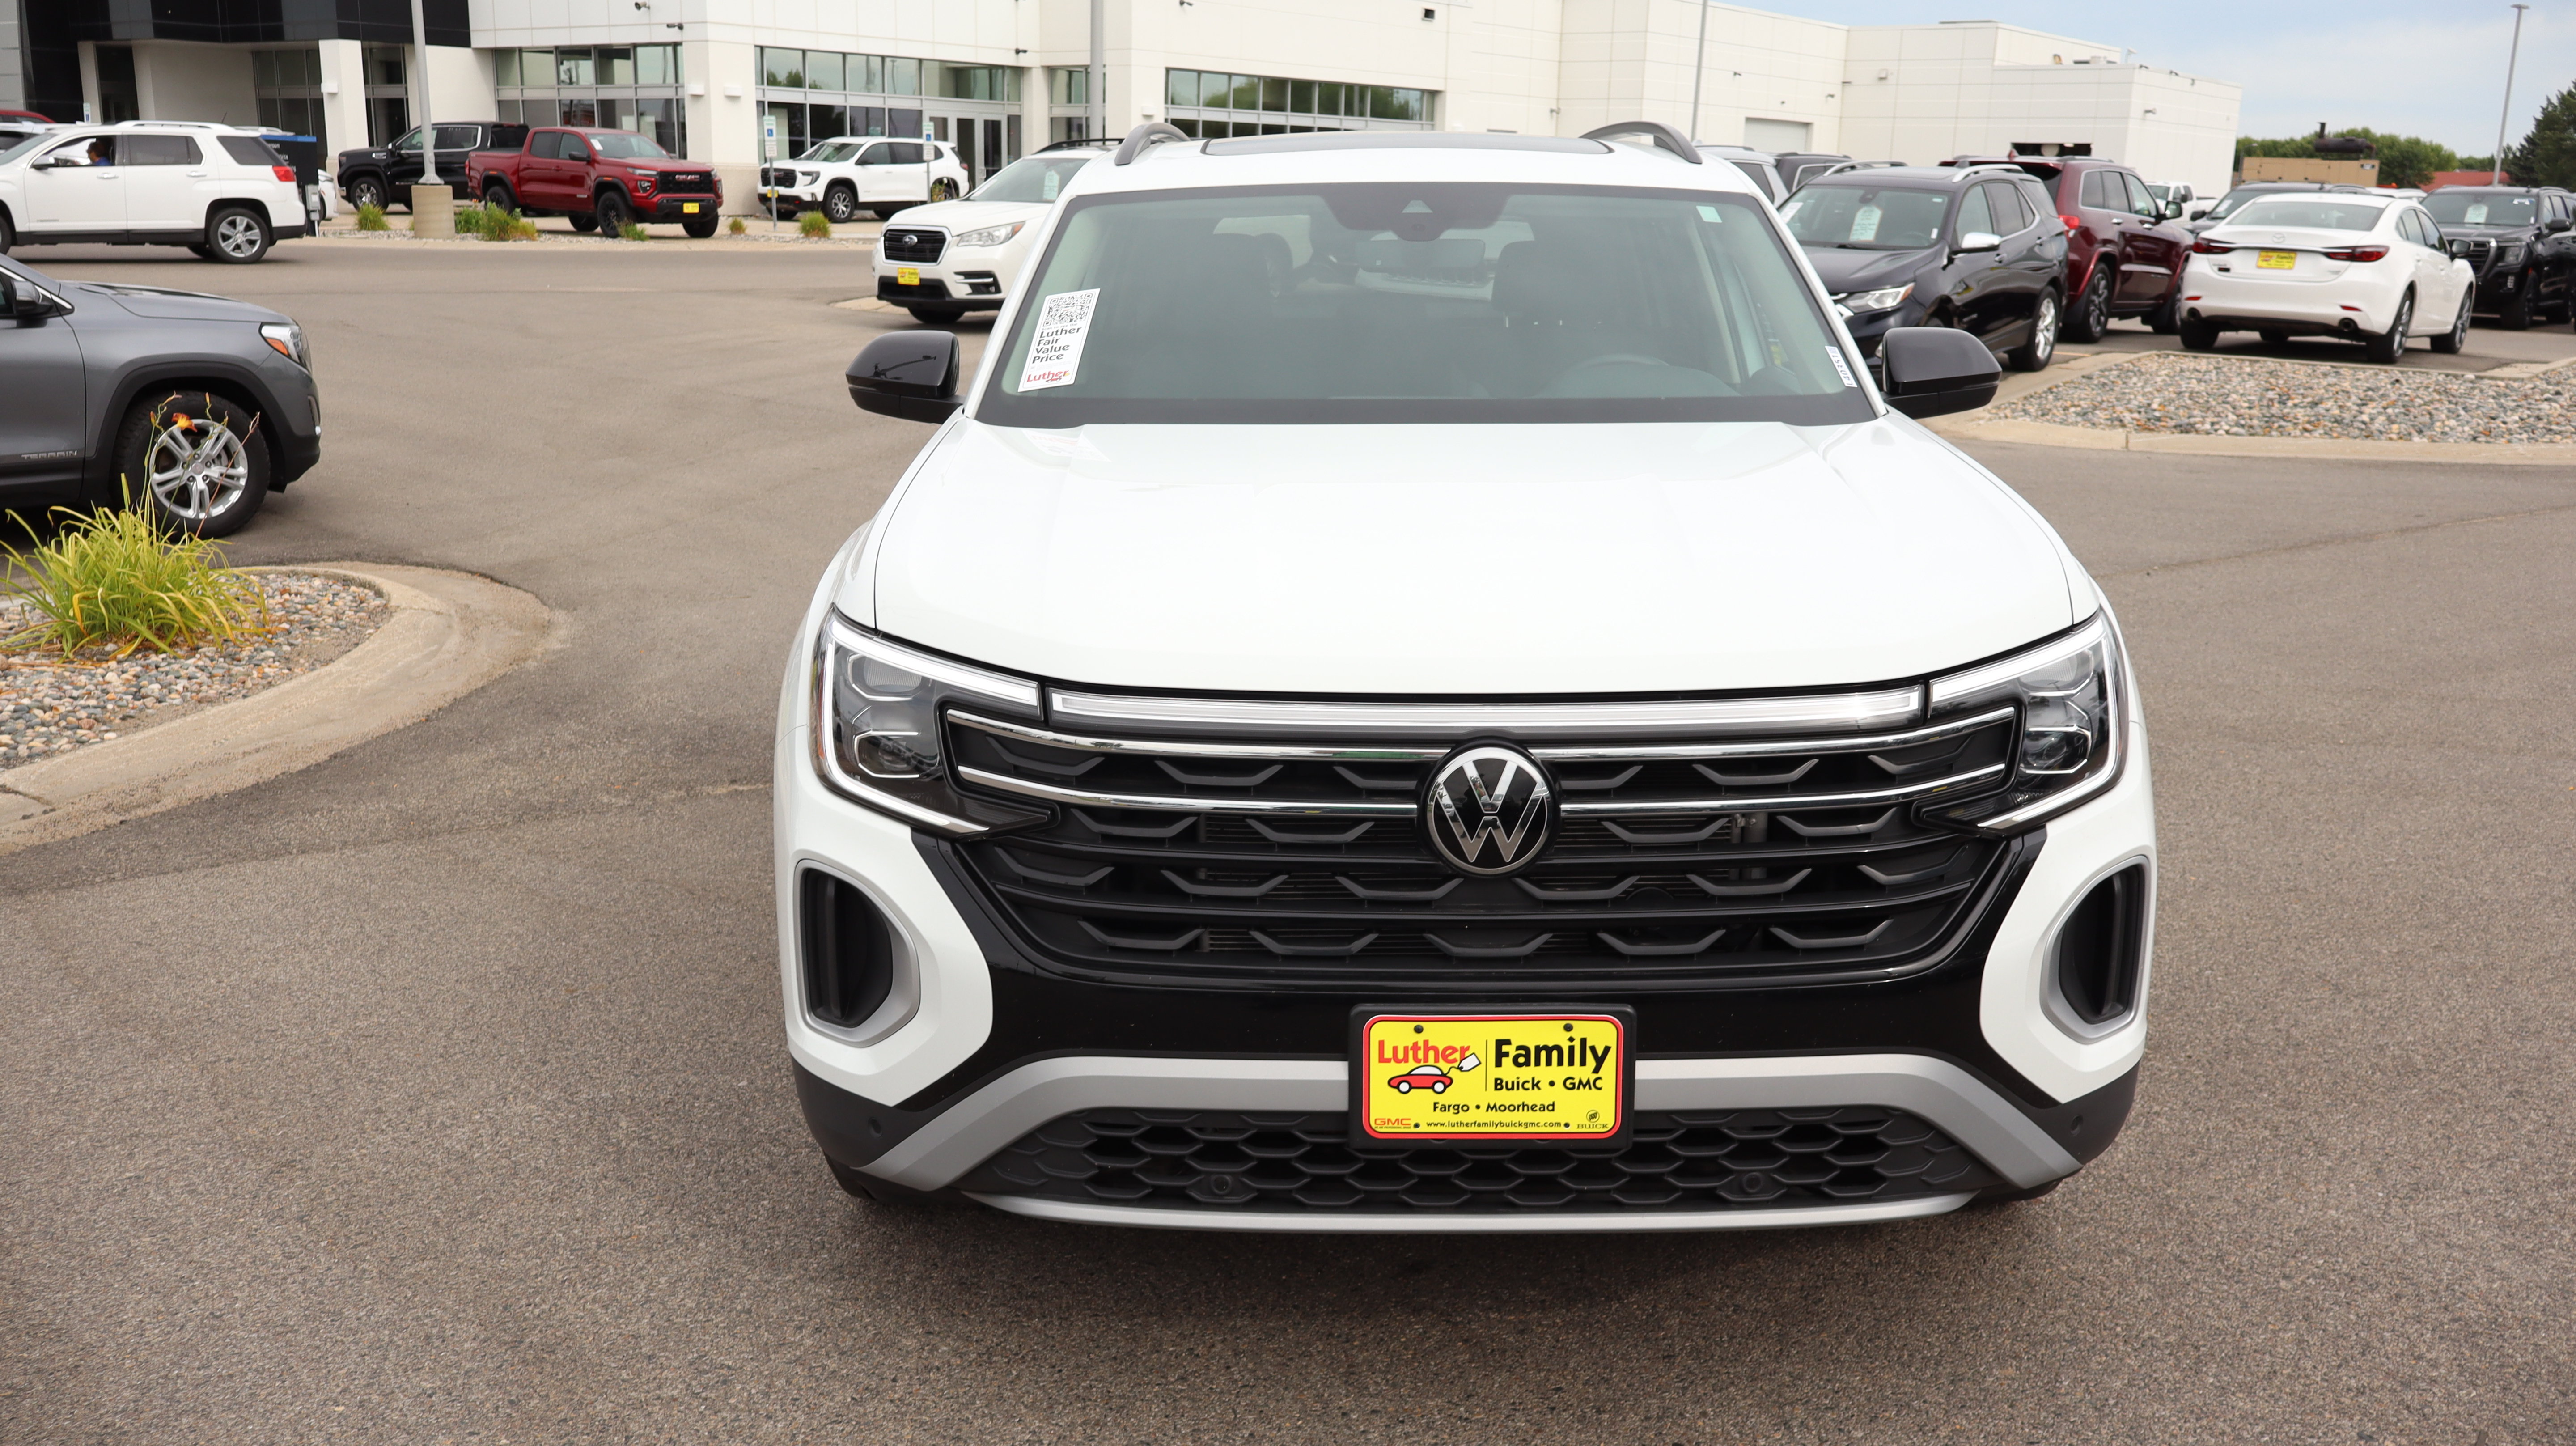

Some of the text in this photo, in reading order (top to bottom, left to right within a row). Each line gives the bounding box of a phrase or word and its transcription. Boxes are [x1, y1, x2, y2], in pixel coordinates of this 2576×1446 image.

[1040, 327, 1082, 339] Luther
[1037, 337, 1060, 347] Fair
[1035, 345, 1070, 354] Value
[1032, 354, 1064, 364] Price
[1027, 370, 1069, 382] Luther
[1378, 1039, 1470, 1064] Luther
[1494, 1036, 1612, 1073] Family
[1494, 1076, 1603, 1091] Buick GMC
[1433, 1101, 1555, 1115] Fargo Moorhead
[1426, 1120, 1561, 1128] www.lutherfamilybuickgmc.com
